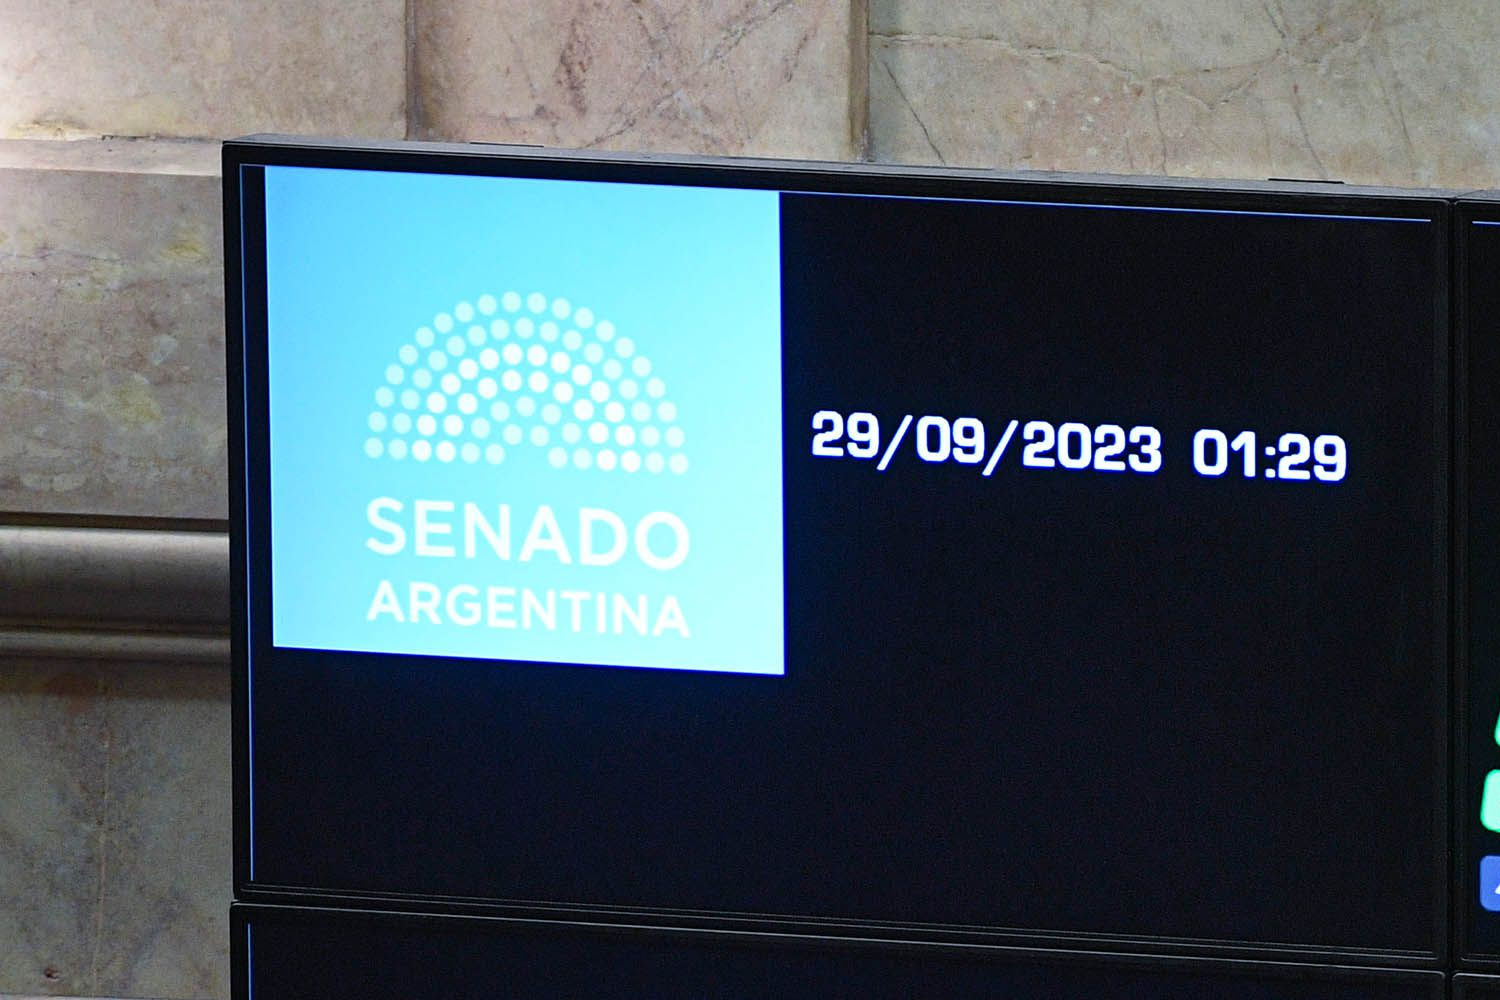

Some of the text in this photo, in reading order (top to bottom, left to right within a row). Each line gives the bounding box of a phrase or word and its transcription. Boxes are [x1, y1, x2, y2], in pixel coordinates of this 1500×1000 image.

[812, 410, 1347, 482] 29/09/2023 01:29
[367, 497, 691, 571] SENADO
[367, 580, 692, 639] ARGENTINA
